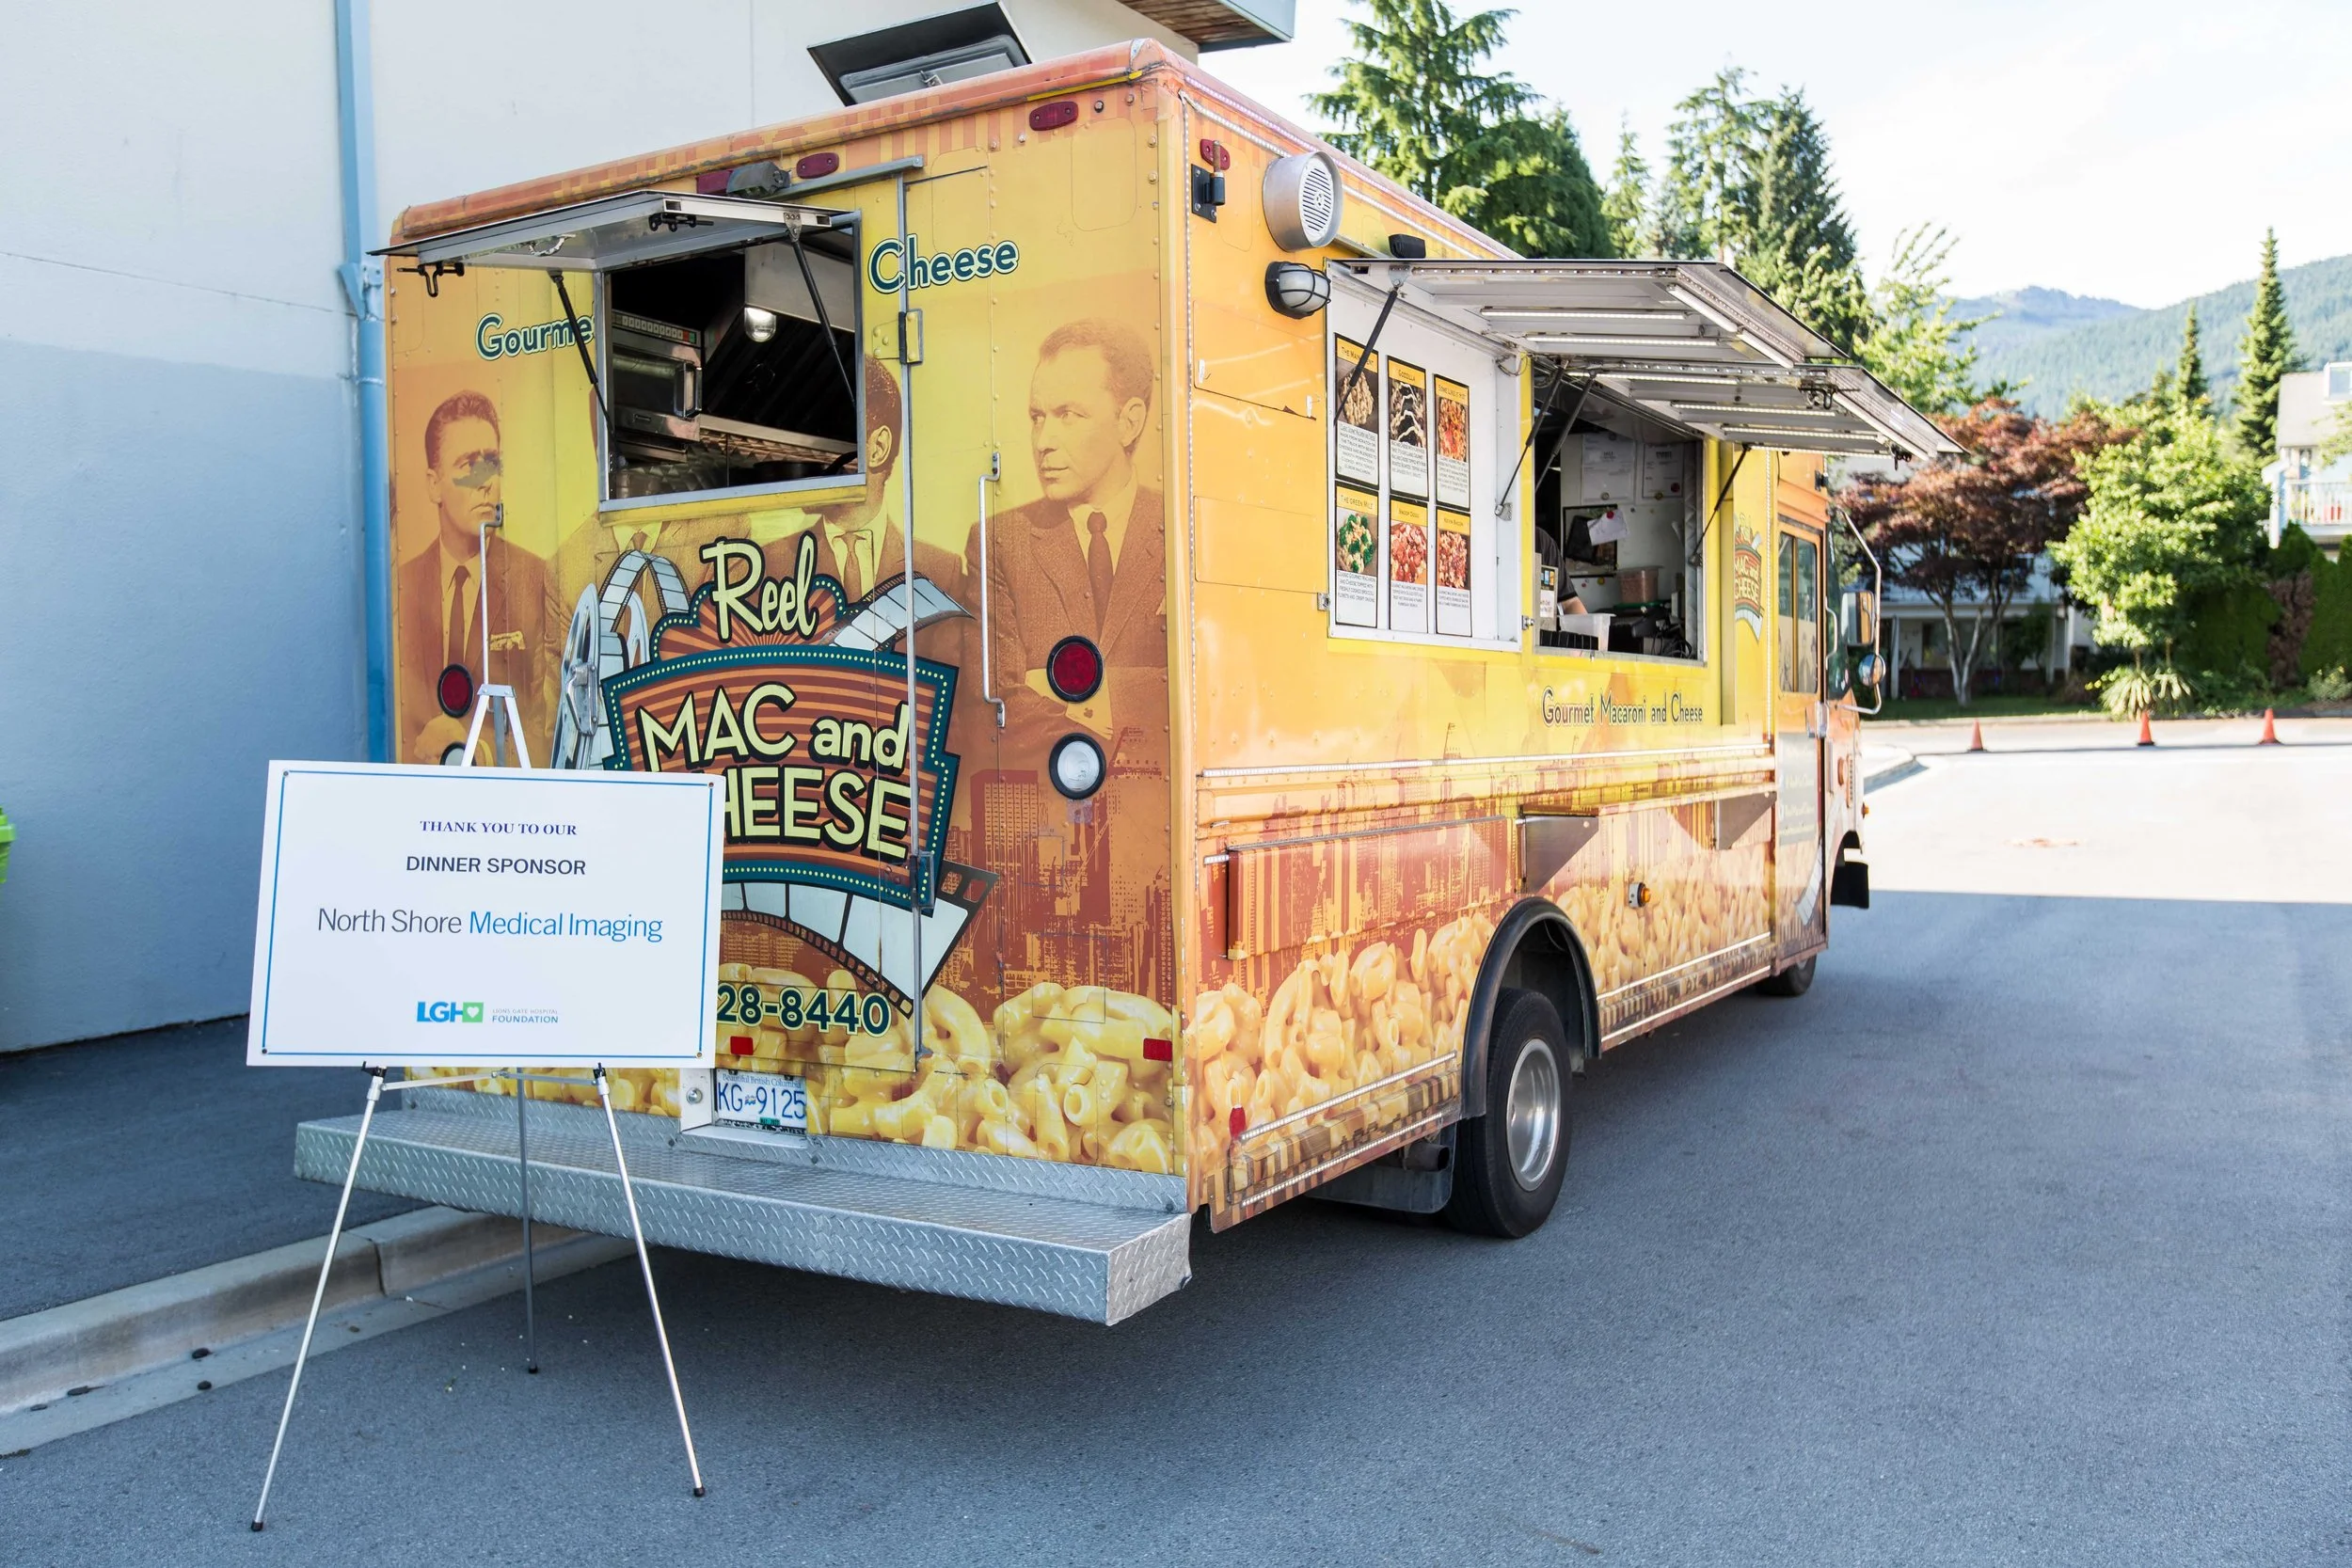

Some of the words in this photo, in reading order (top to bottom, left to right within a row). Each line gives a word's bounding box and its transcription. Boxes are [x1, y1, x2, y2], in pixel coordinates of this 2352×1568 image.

[868, 234, 1020, 293] Cheese
[475, 312, 595, 361] Gourme
[1341, 494, 1349, 504] THE
[1349, 498, 1363, 507] GREEN
[700, 531, 819, 643] Reel
[1542, 688, 1595, 725] Gourmet
[1600, 690, 1646, 724] Macaroni
[1651, 691, 1667, 723] and
[1671, 690, 1704, 723] Cheese
[635, 680, 799, 774] MAC
[809, 702, 911, 775] and
[420, 821, 478, 834] THANK
[482, 822, 516, 835] YOU
[518, 823, 541, 835] TO
[543, 824, 578, 836] OUR
[724, 765, 912, 865] HEESE
[405, 856, 482, 874] DINNER
[485, 857, 586, 876] SPONSOR
[318, 908, 386, 933] North
[391, 909, 462, 934] Shore
[469, 911, 564, 937] Medical
[569, 912, 663, 943] Imaging
[417, 1001, 464, 1023] LGH
[492, 1015, 559, 1023] FOUNDATION
[717, 982, 892, 1037] 28-8440
[723, 1073, 750, 1084] Beautiful
[751, 1074, 771, 1085] British
[771, 1079, 803, 1088] Columbia
